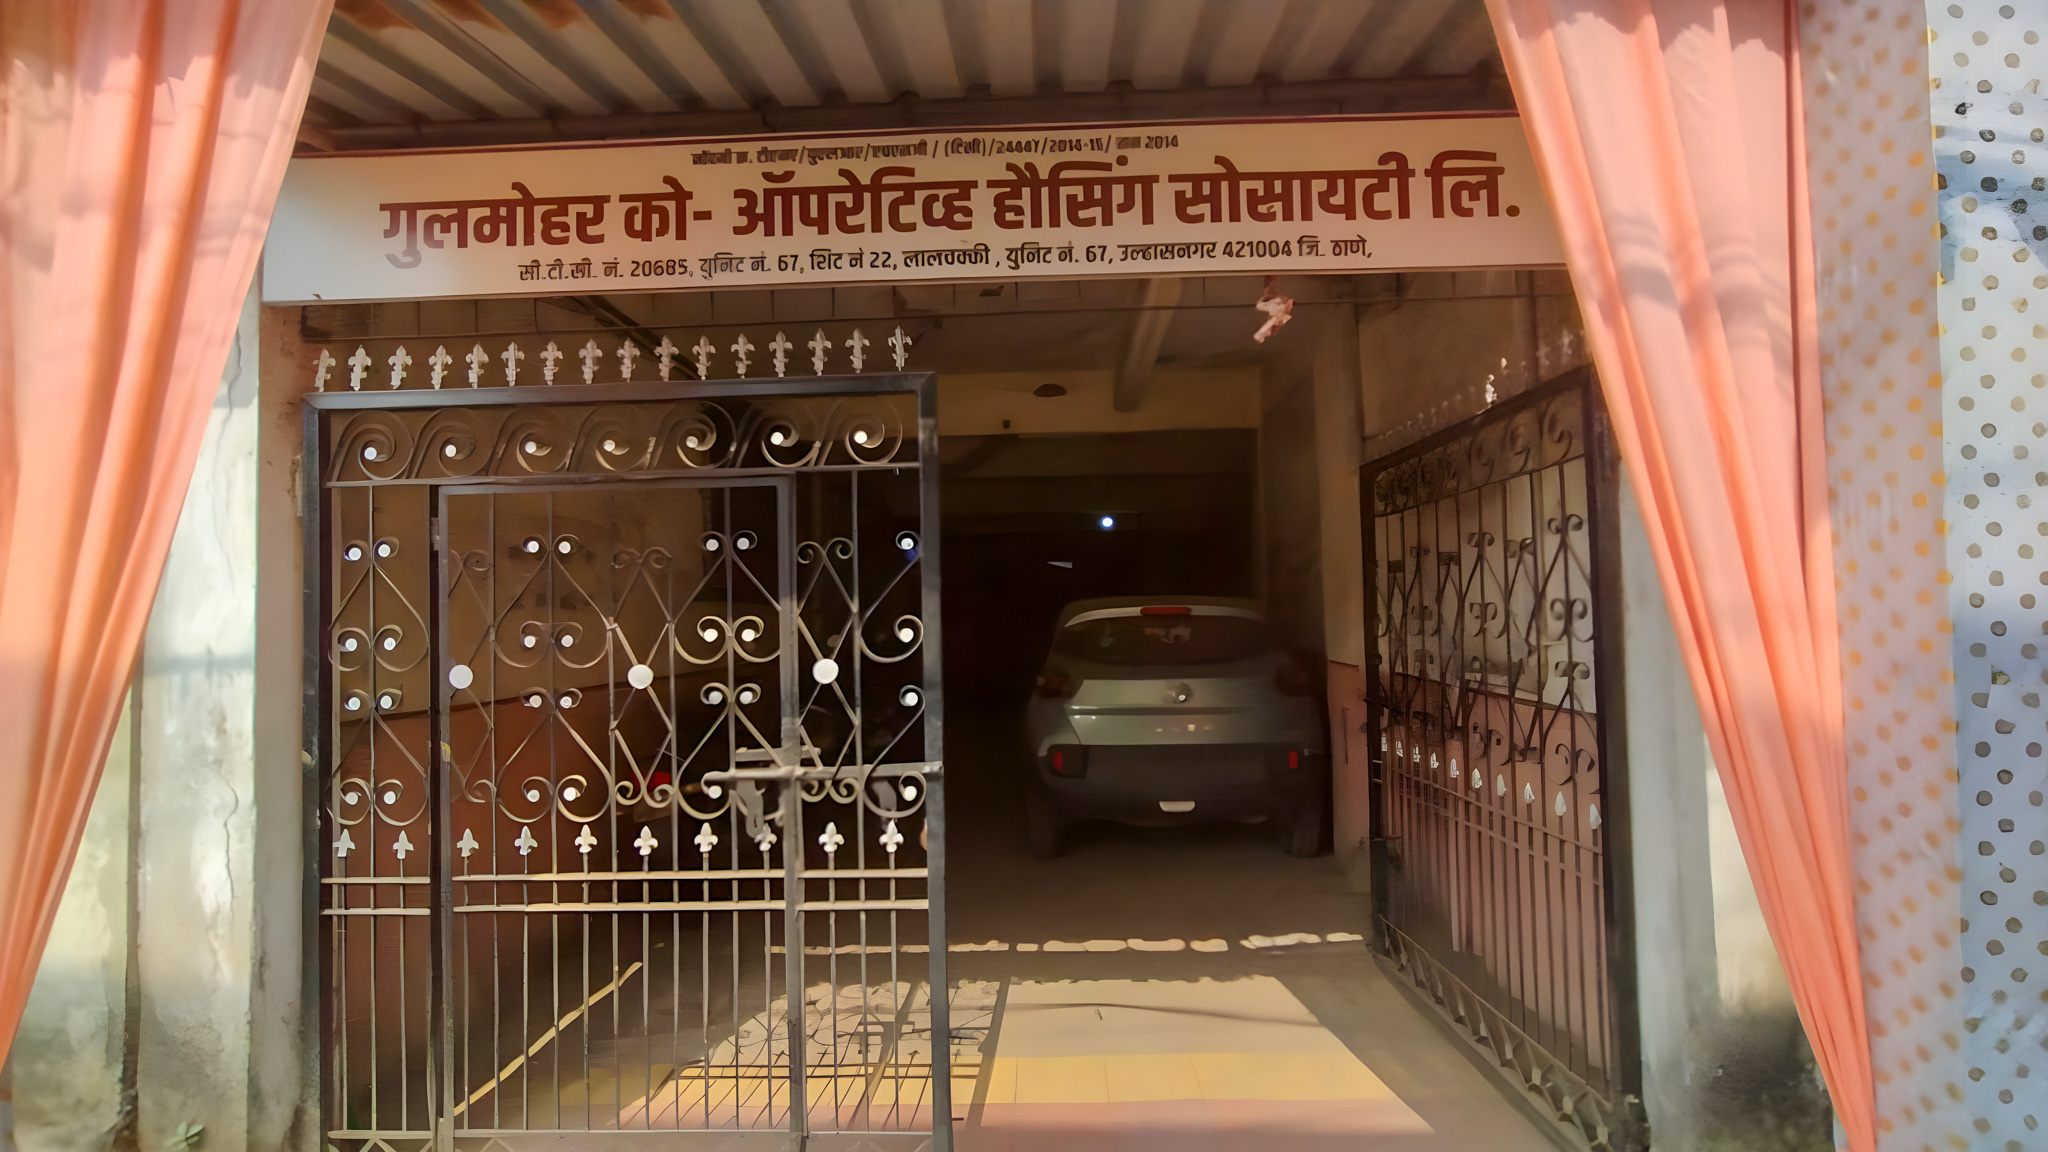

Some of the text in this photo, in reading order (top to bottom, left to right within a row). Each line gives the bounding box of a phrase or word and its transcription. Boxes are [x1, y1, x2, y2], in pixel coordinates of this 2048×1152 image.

[379, 149, 1522, 269] गुलमोहर को- ऑपरेटिव्ह हौसिंग सोसायटी लि.
[869, 251, 897, 270] 22,
[1004, 242, 1053, 270] युनिट
